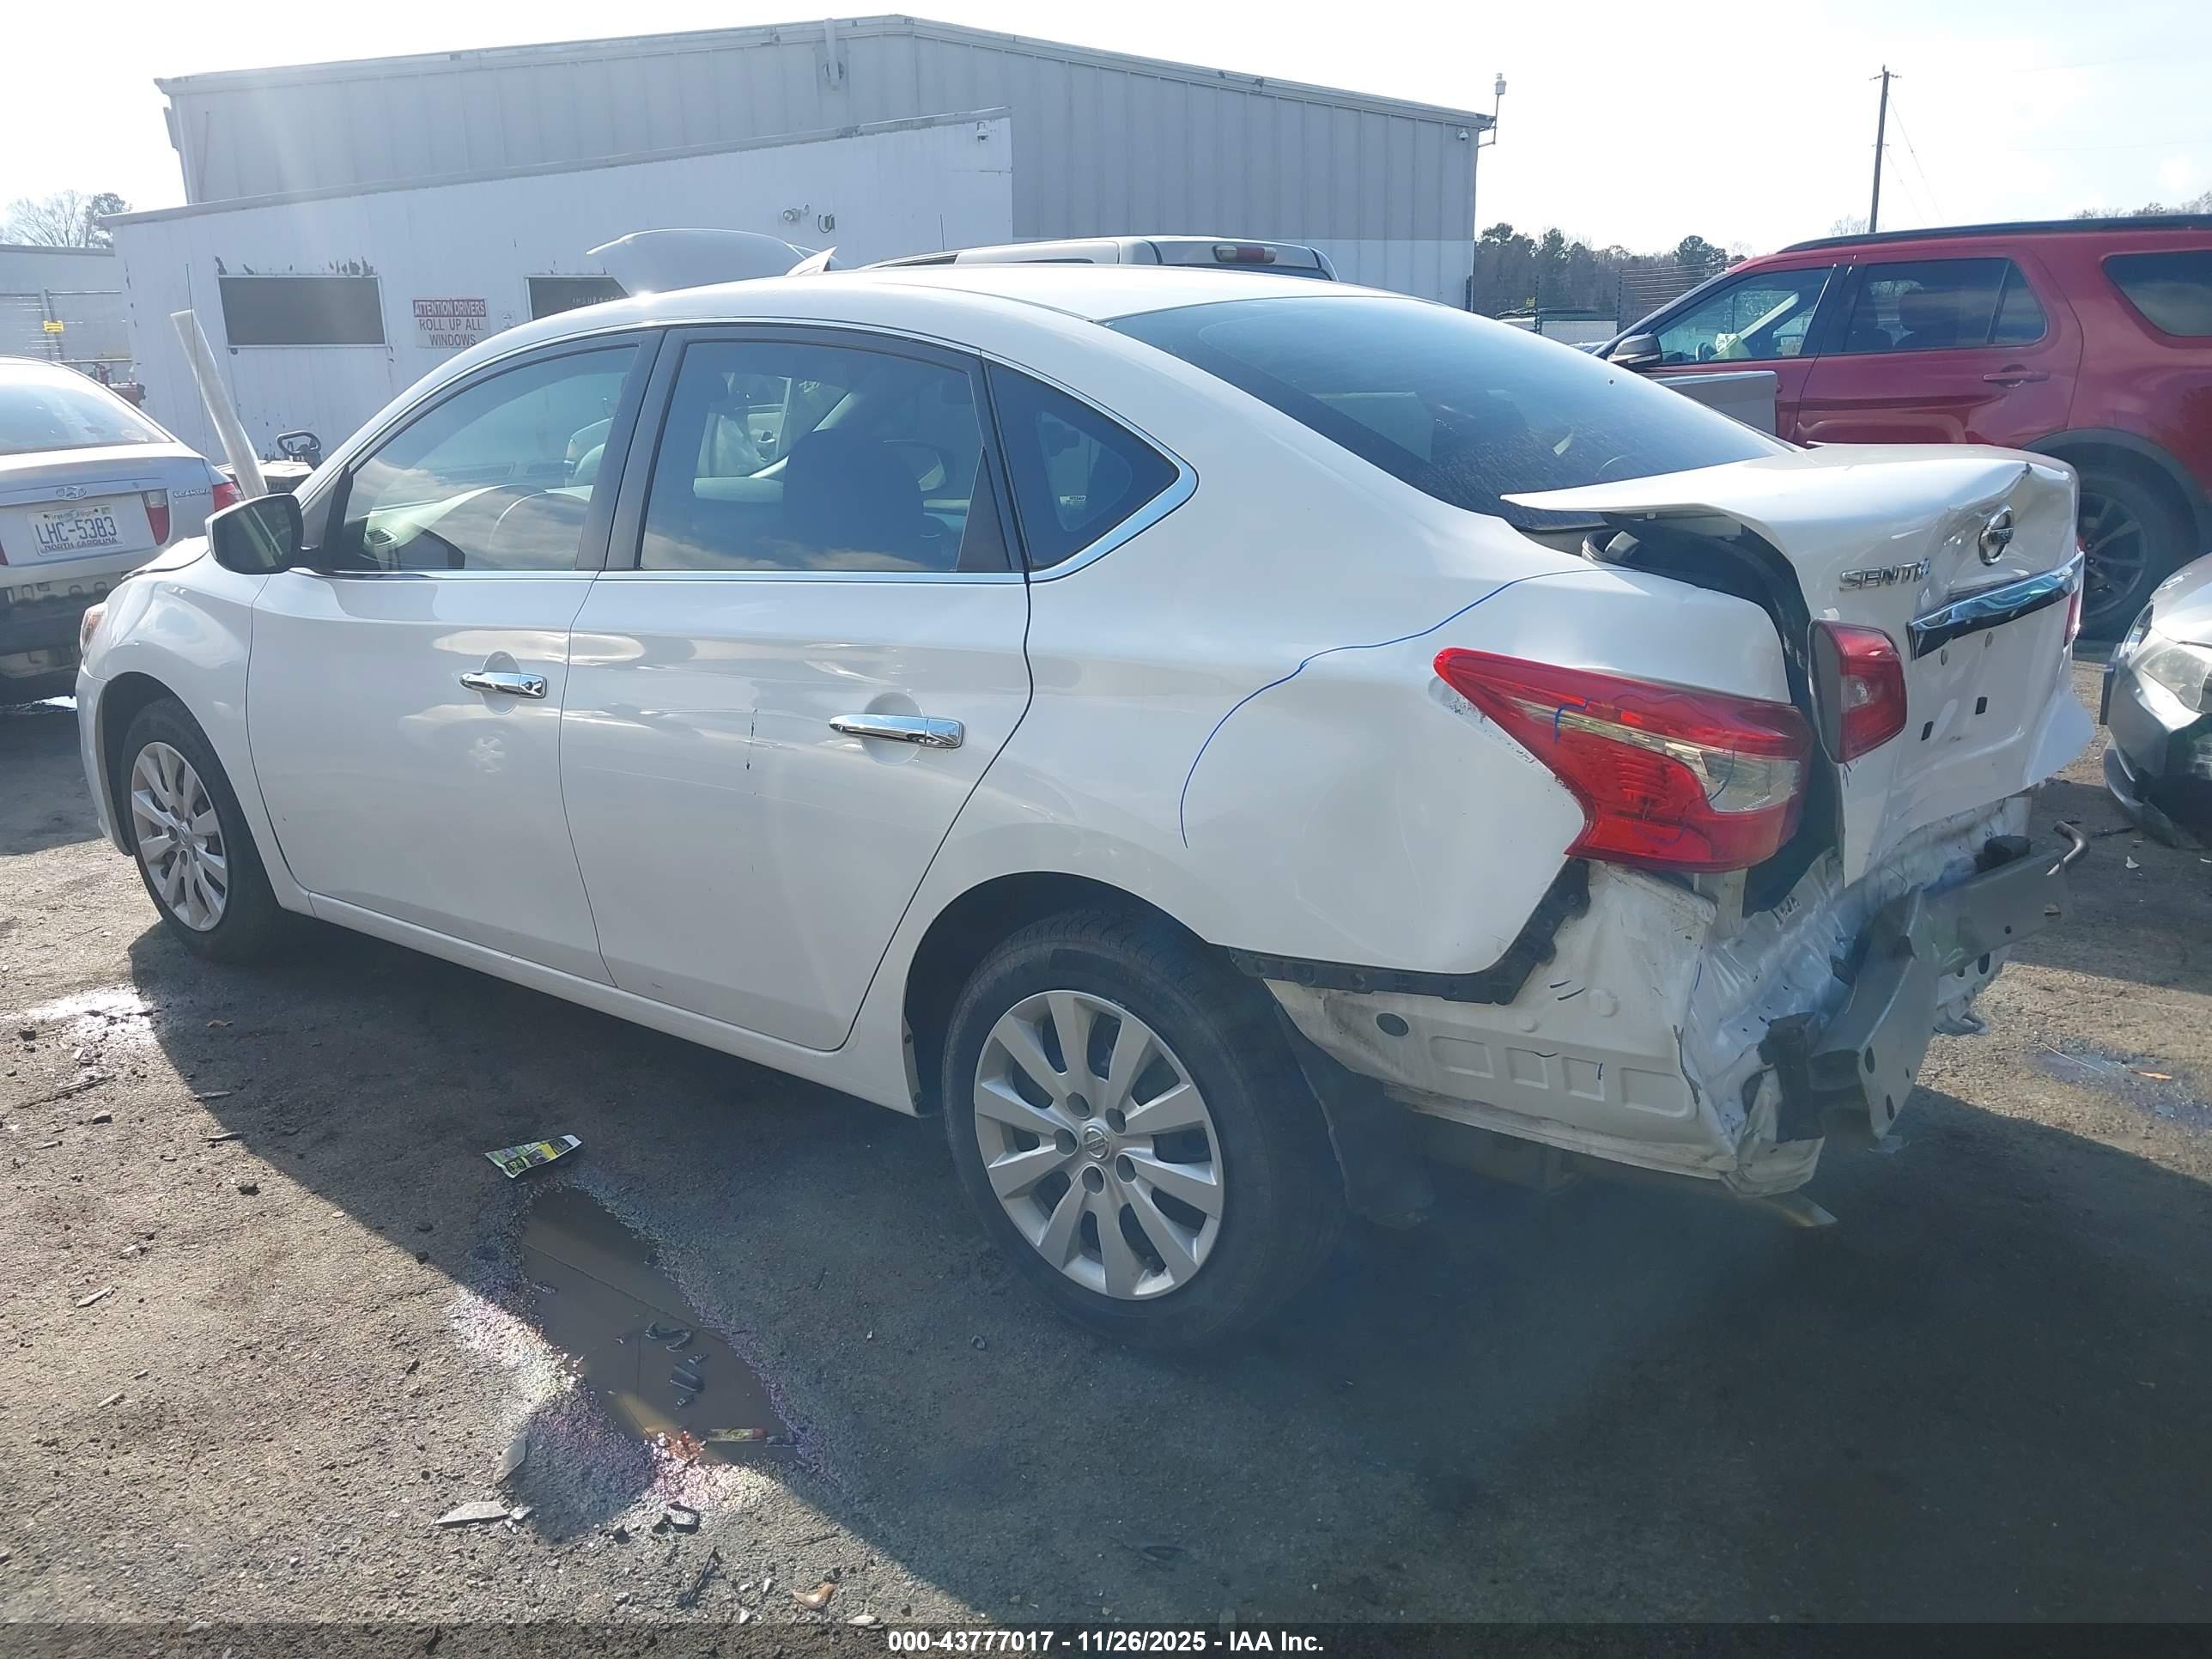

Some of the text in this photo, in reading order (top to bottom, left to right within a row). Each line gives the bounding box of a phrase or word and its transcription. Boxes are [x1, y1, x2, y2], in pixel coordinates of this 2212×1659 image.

[415, 301, 485, 316] ATTENTION DRIVERS
[418, 318, 484, 331] ROLL UP ALL
[428, 333, 477, 347] WINDOWS
[34, 516, 118, 544] LHC-5383
